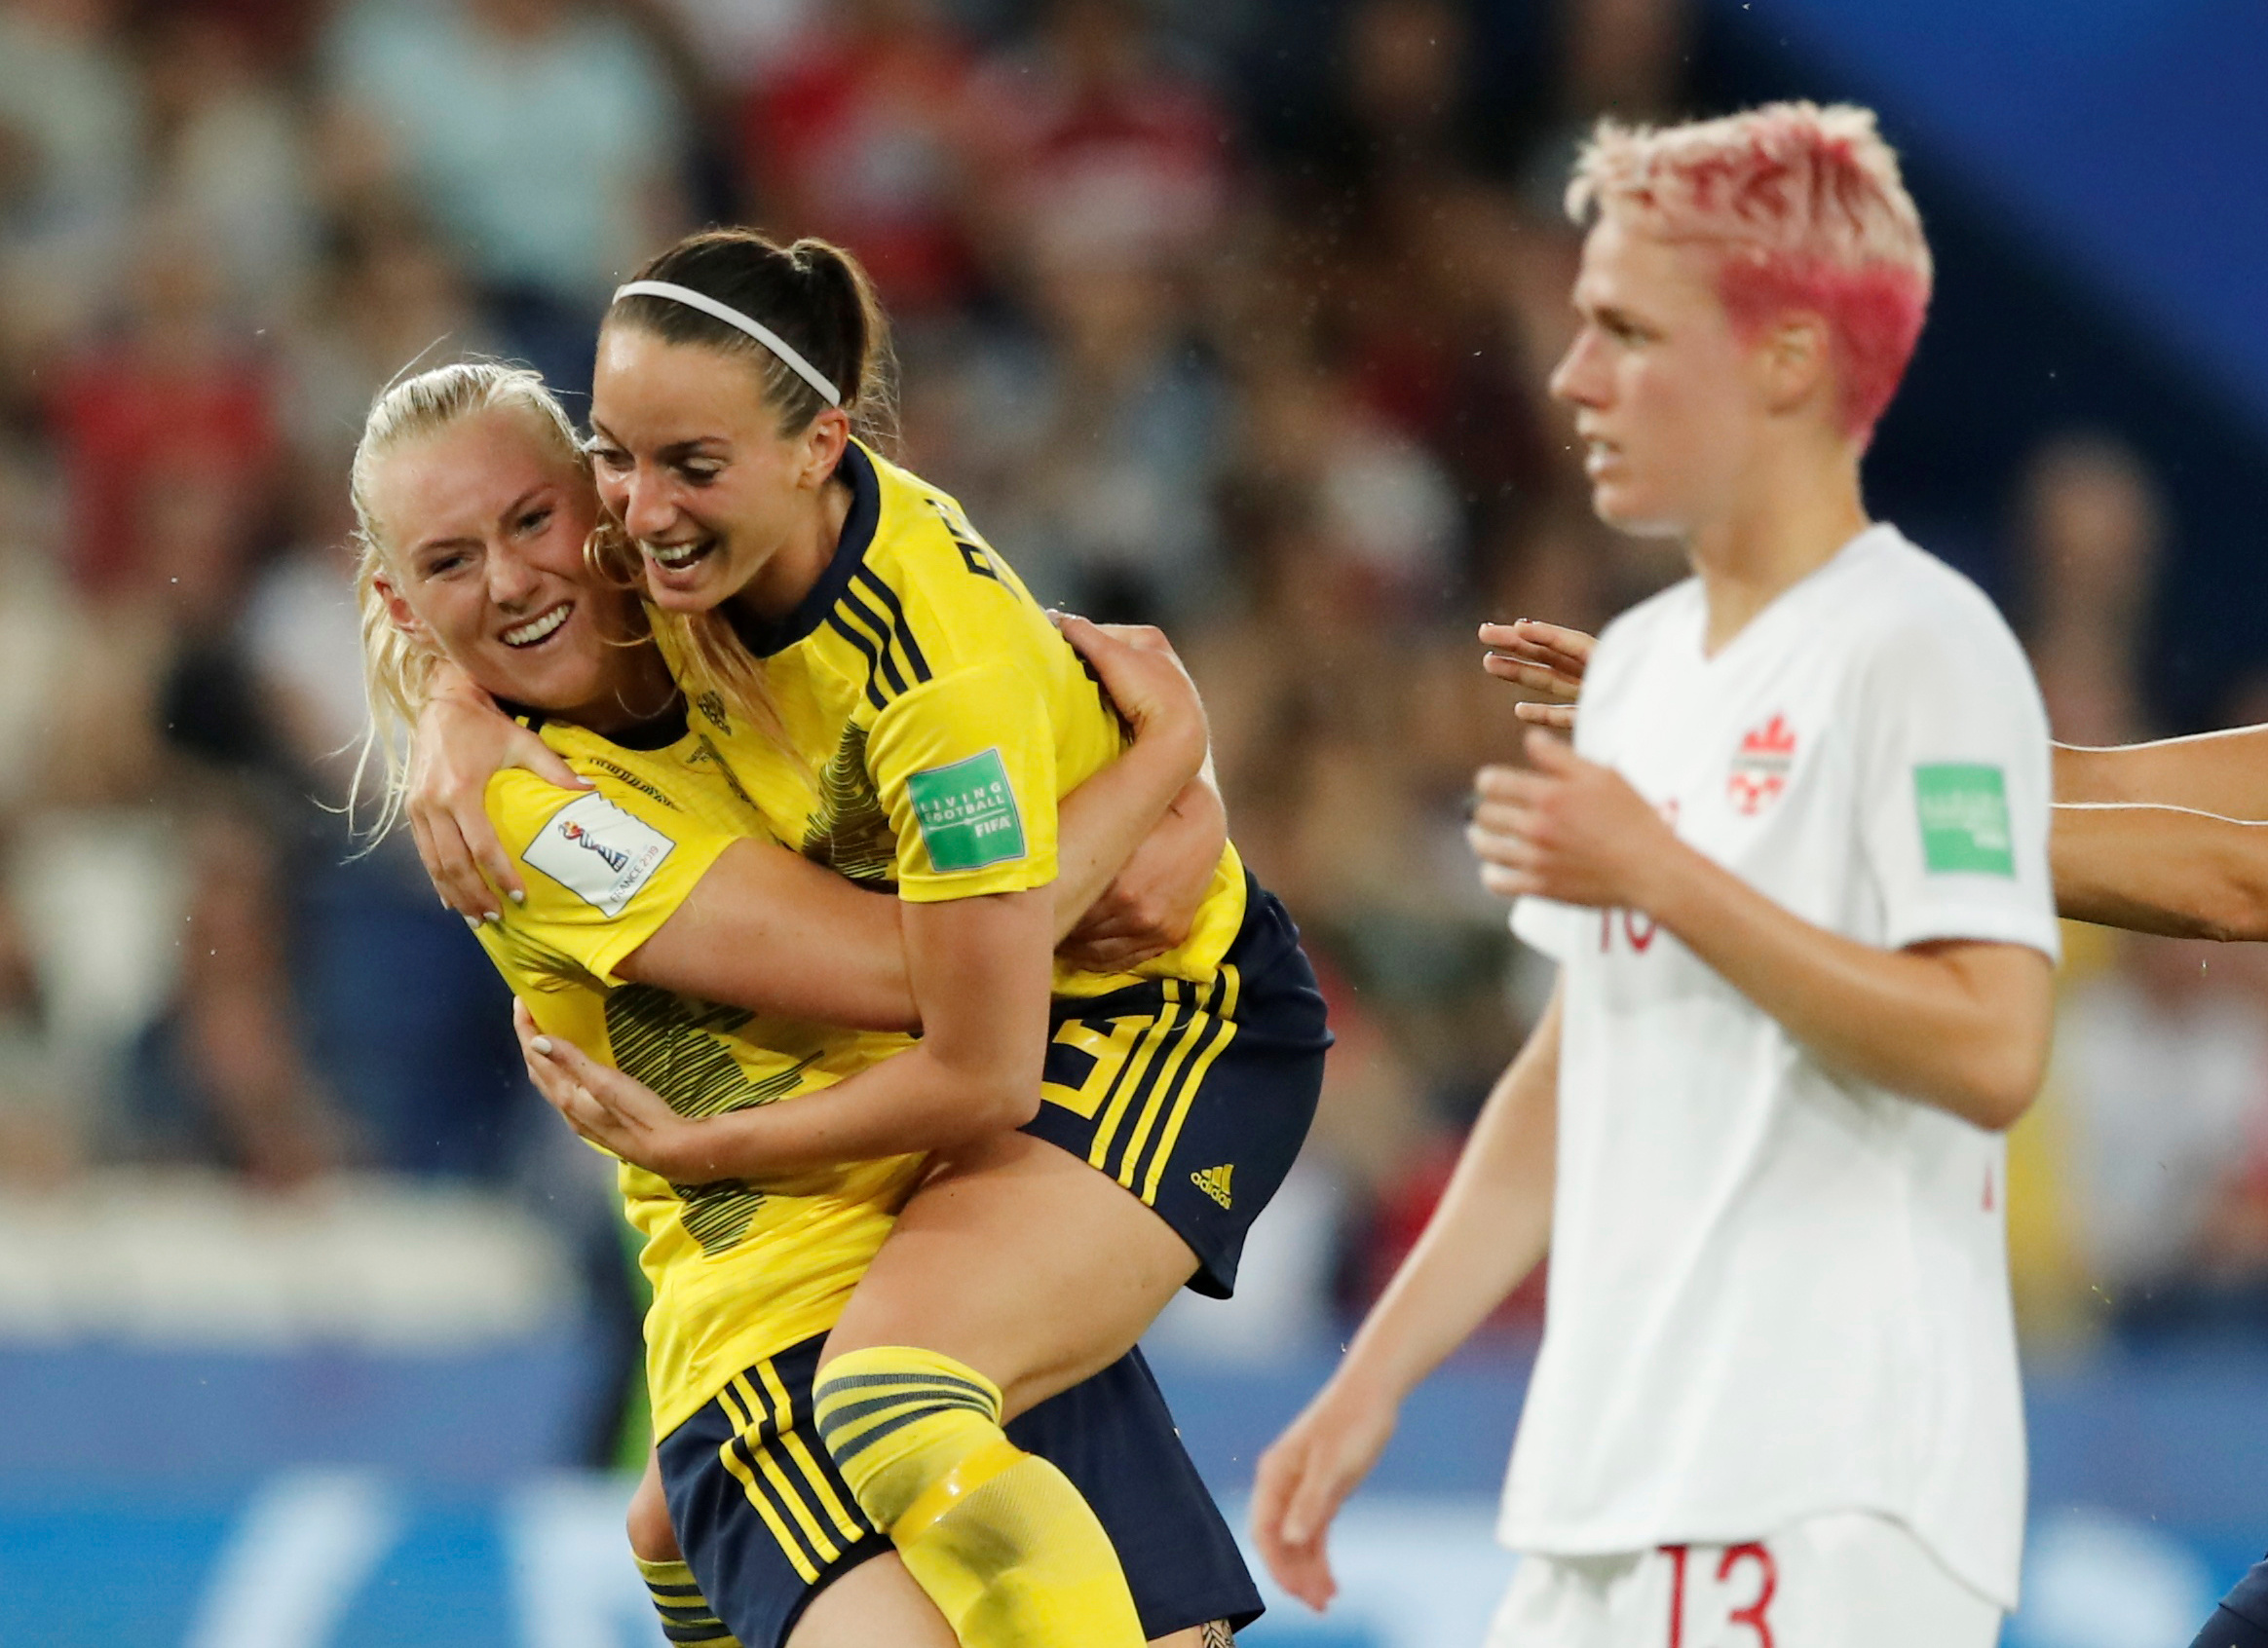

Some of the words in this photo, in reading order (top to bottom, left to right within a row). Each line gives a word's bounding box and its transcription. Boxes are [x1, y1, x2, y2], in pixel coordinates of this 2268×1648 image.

[920, 781, 1002, 811] LIVING
[974, 815, 1011, 838] FIFA
[1190, 1172, 1232, 1211] adidas
[1657, 1542, 1780, 1648] 13
